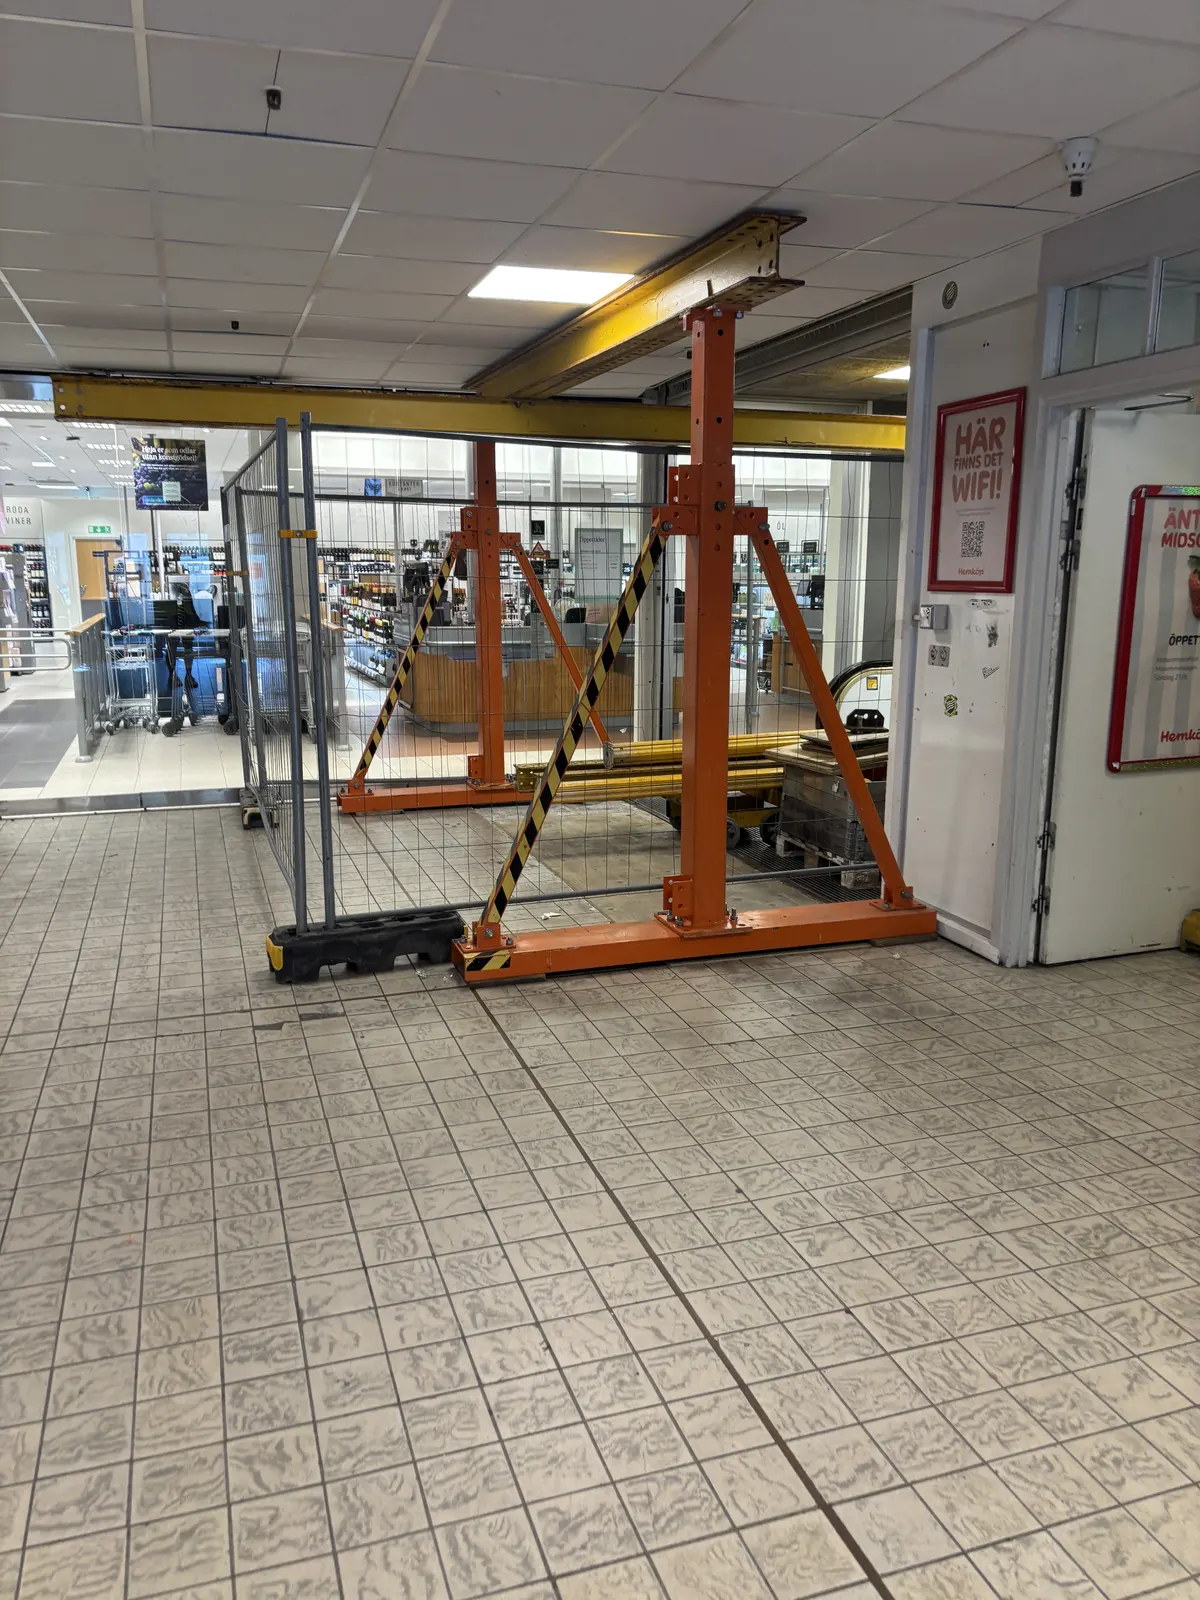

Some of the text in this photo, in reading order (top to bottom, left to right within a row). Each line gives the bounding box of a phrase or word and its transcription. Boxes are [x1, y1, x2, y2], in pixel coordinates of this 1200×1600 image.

[955, 416, 1006, 456] HÄR
[142, 446, 157, 454] Heja
[954, 452, 1004, 471] FINNS DET
[952, 467, 1002, 503] WIFI!
[5, 517, 32, 525] VINER
[1164, 507, 1200, 530] ÄNT
[958, 567, 984, 576] Hemköp
